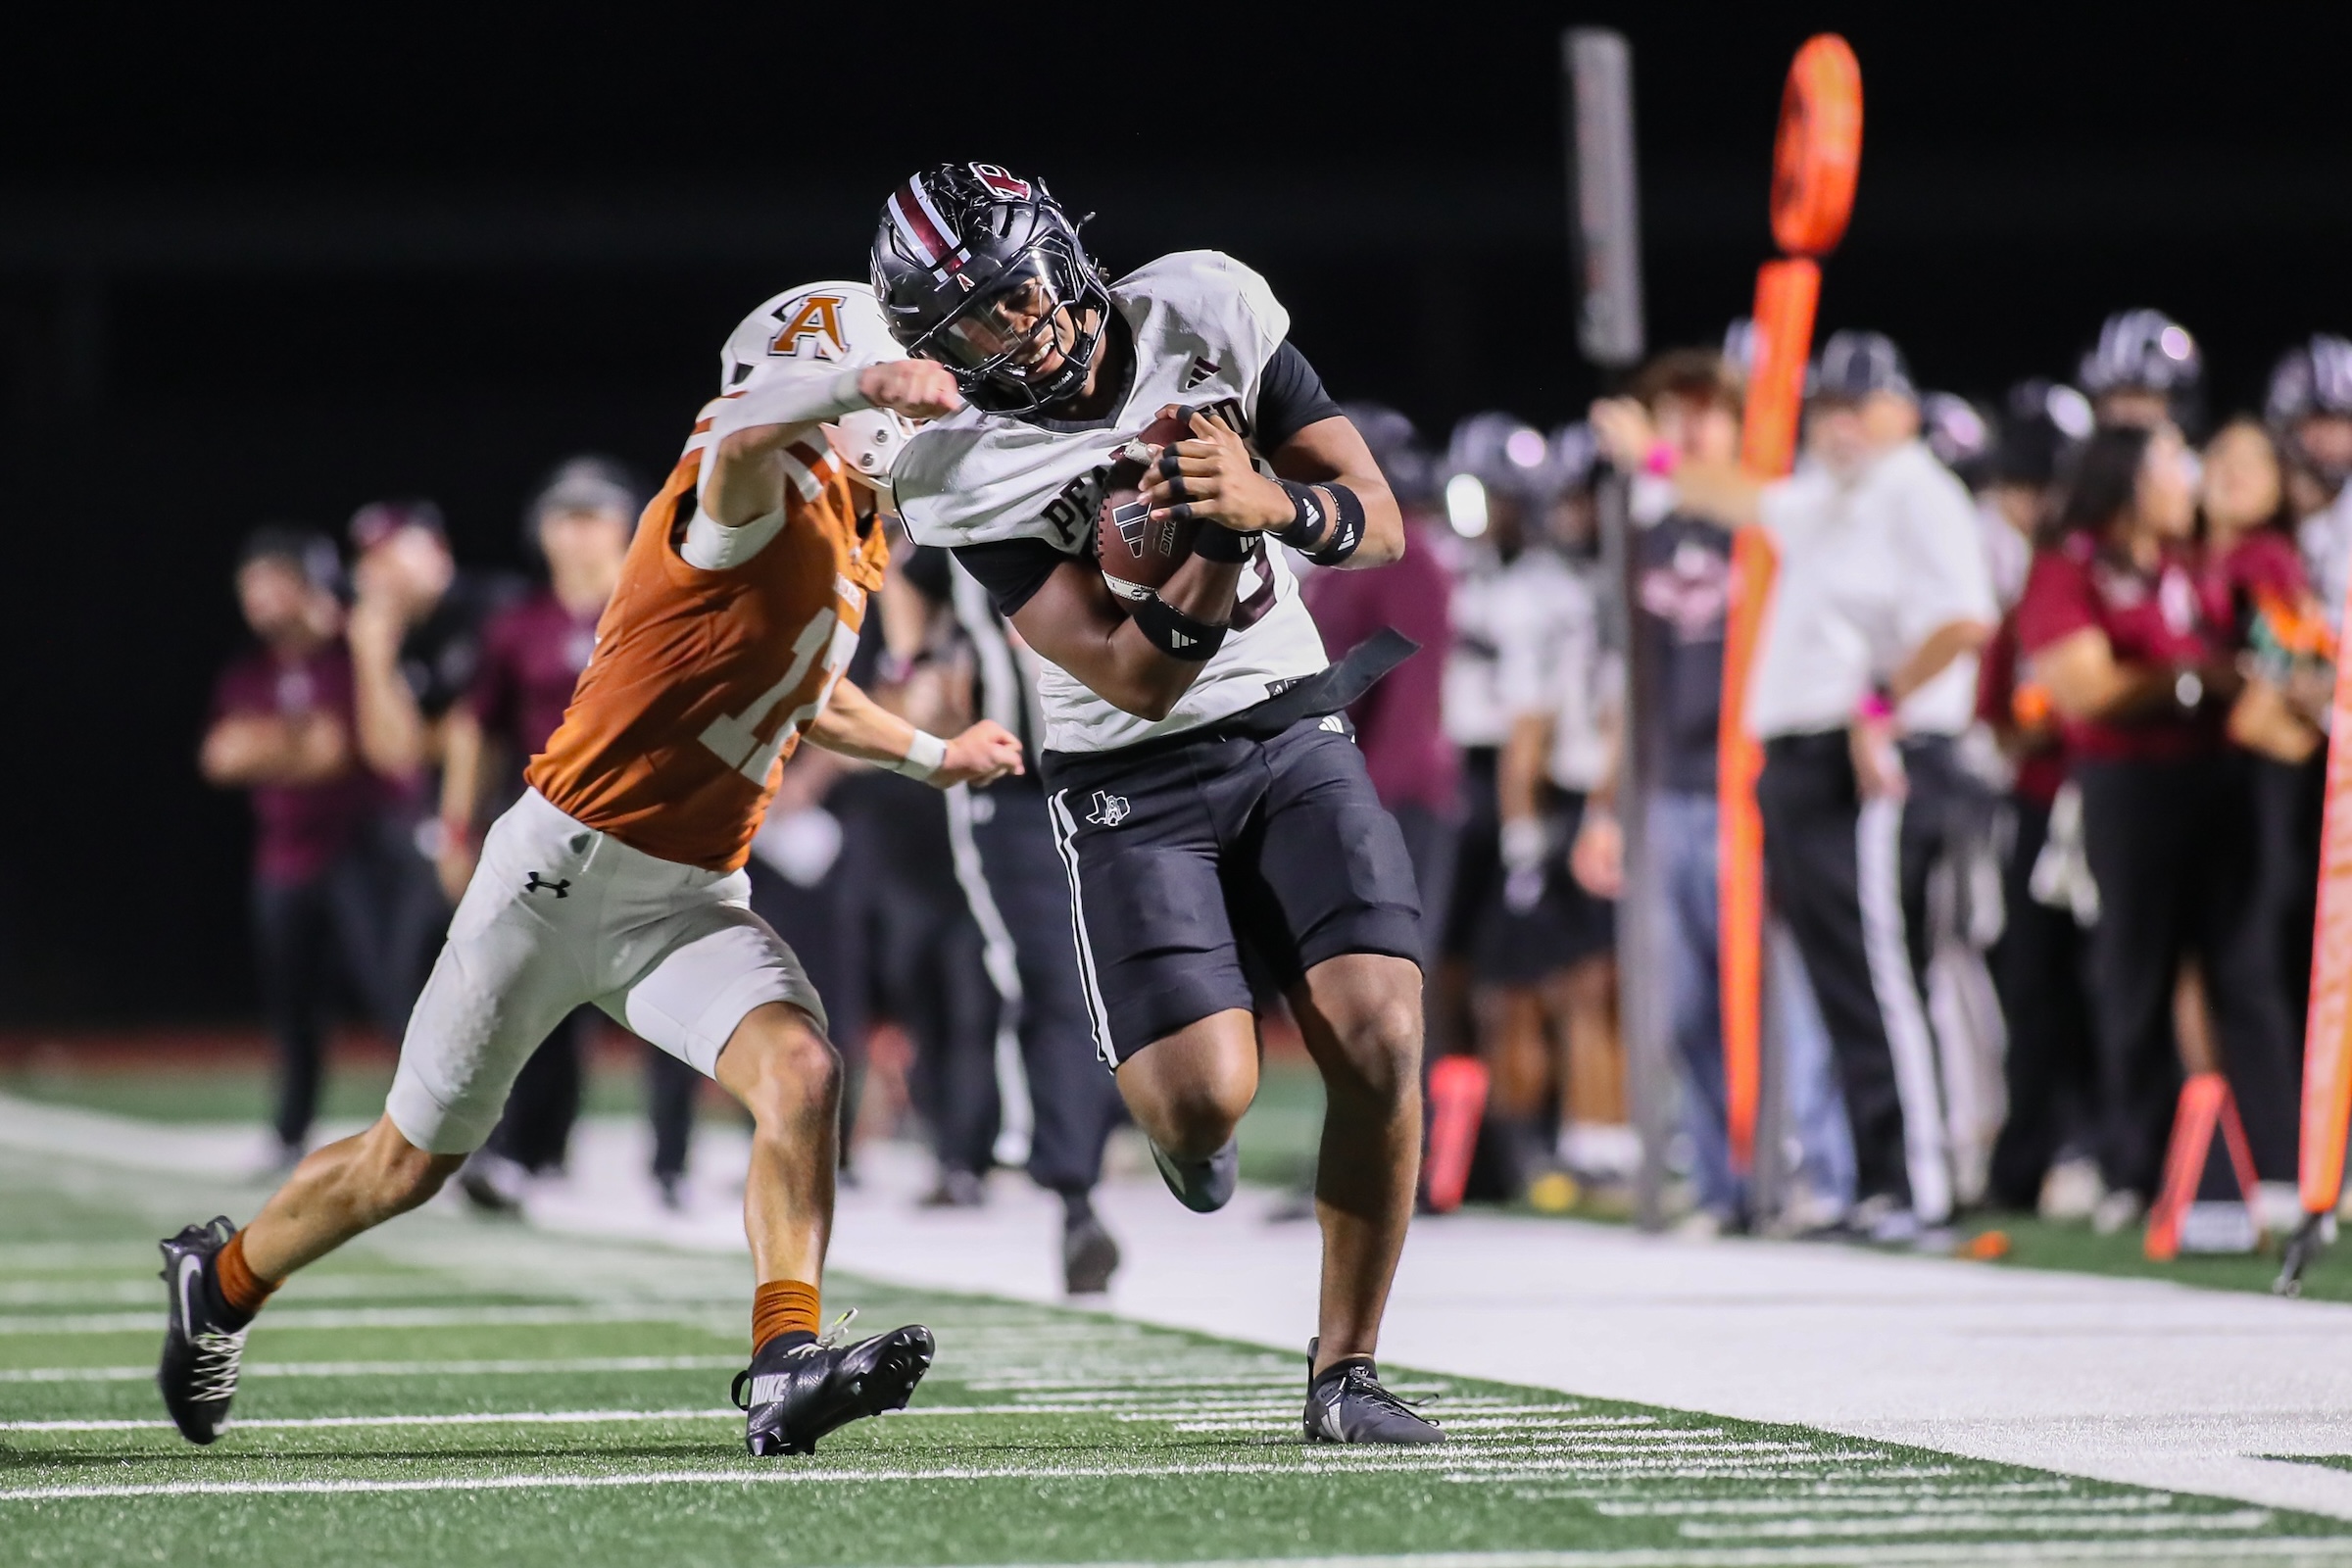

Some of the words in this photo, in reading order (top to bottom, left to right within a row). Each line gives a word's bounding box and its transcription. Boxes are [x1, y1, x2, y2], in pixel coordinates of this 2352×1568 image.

[968, 161, 1032, 201] P
[767, 294, 851, 362] A
[1050, 369, 1074, 392] Riddell
[1158, 519, 1177, 558] DIM
[750, 1372, 791, 1408] NIKE
